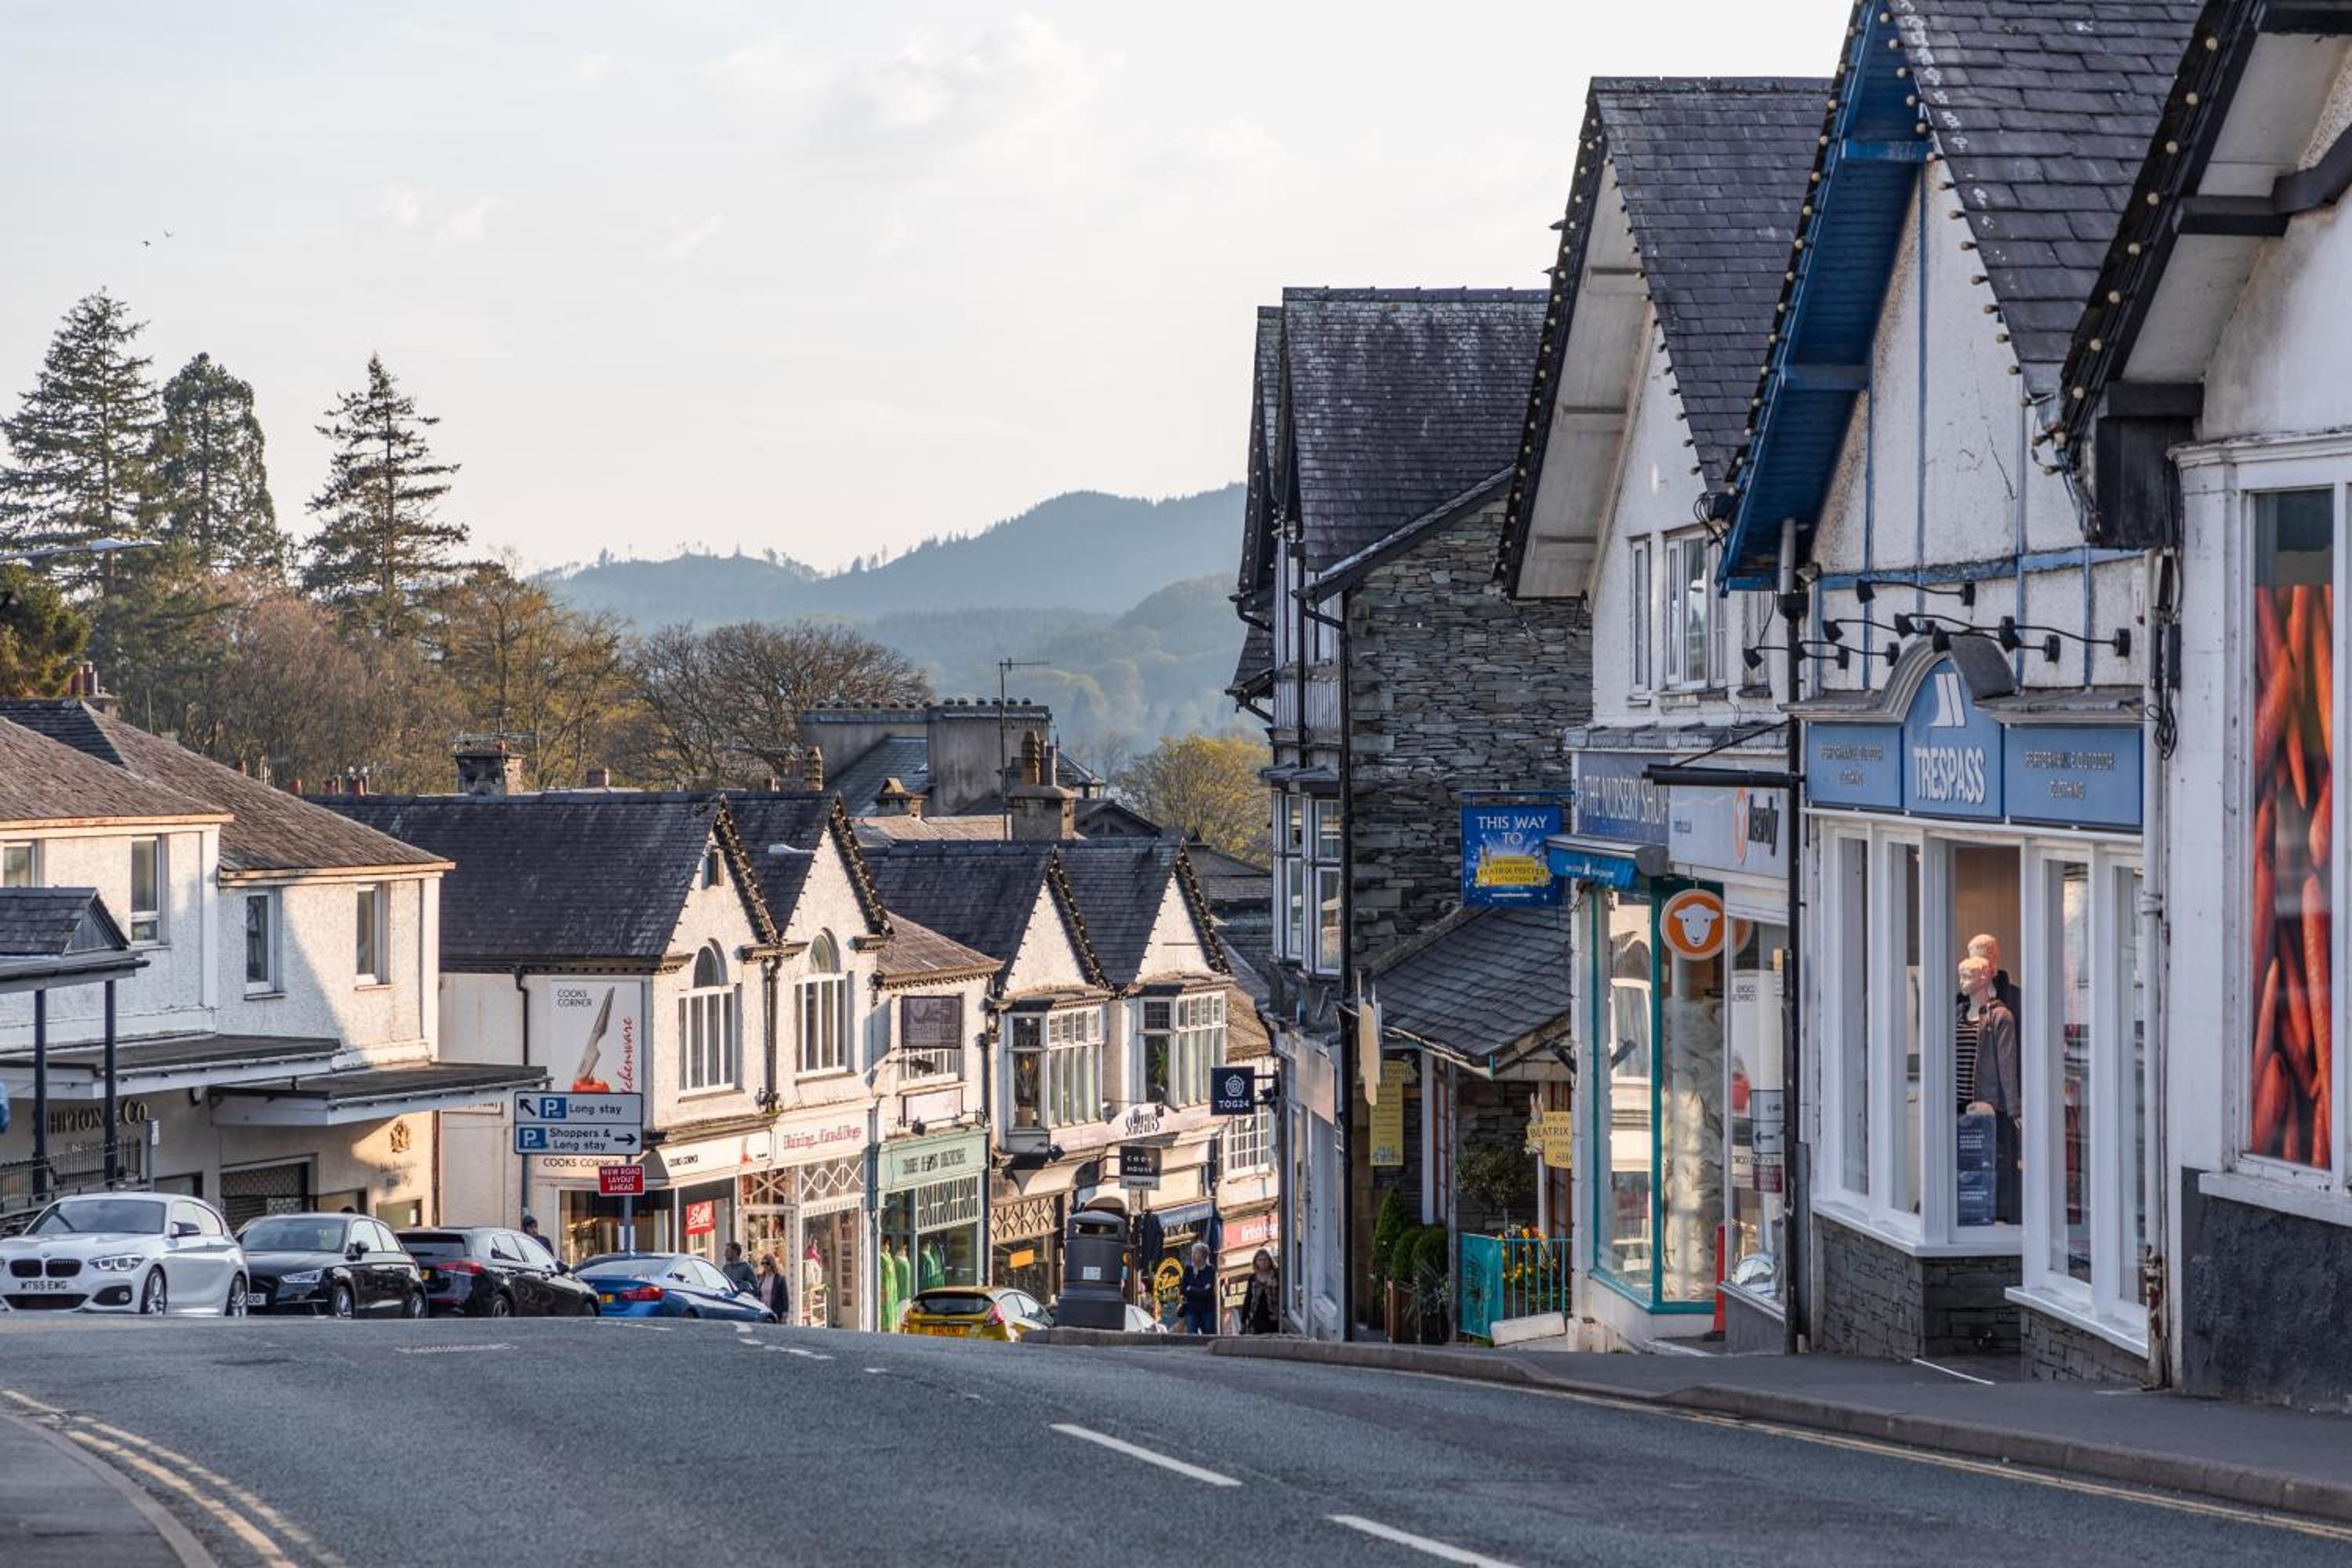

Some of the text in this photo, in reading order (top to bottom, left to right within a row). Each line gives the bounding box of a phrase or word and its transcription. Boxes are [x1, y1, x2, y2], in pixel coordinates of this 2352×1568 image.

[1913, 747, 1986, 804] TRESPASS
[1584, 776, 1606, 815] THE
[1477, 815, 1547, 829] THIS WAY
[1748, 794, 1779, 857] herdy
[1501, 832, 1523, 845] TO
[557, 989, 587, 998] COOKS
[557, 999, 592, 1007] CORNER
[569, 1105, 595, 1115] Long
[600, 1104, 622, 1115] stay
[1218, 1100, 1250, 1109] TOG24
[49, 1109, 104, 1131] HIPTON
[550, 1128, 599, 1139] Shoppers
[603, 1129, 612, 1138] &
[1530, 1127, 1569, 1137] BEATRIX
[554, 1141, 579, 1151] Long
[584, 1140, 607, 1151] stay
[543, 1158, 577, 1167] COOKS
